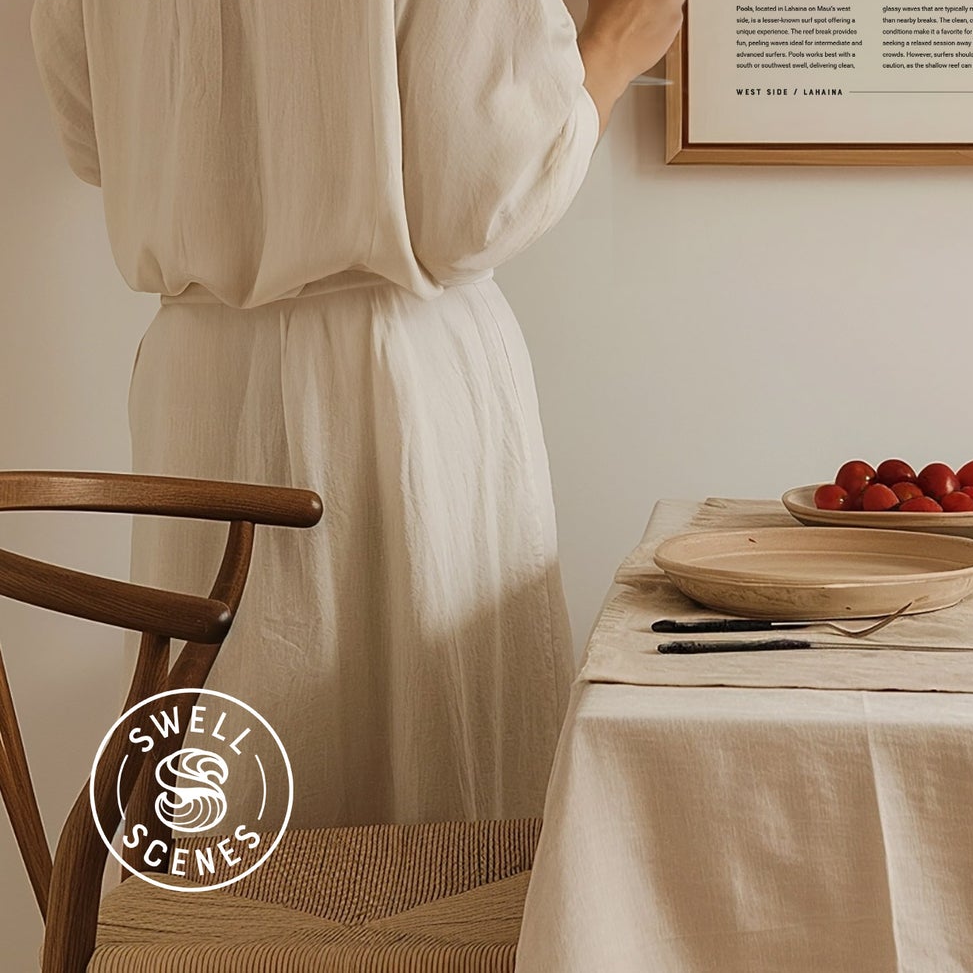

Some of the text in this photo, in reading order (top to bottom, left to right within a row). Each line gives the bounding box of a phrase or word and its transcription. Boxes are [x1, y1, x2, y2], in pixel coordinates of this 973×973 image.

[736, 5, 754, 13] Pools,
[882, 5, 901, 14] glassy
[945, 5, 968, 14] typically
[736, 17, 749, 25] side,
[814, 17, 827, 26] spot
[828, 17, 850, 26] offering
[897, 17, 916, 26] nearby
[952, 17, 968, 25] clean,
[736, 28, 755, 37] unique
[757, 28, 789, 37] experience.
[833, 28, 857, 37] provides
[736, 39, 747, 47] fun,
[748, 39, 769, 48] peeling
[883, 39, 905, 48] seeking
[792, 62, 808, 70] swell,
[809, 62, 837, 71] delivering
[838, 62, 855, 70] clean,
[882, 62, 905, 70] caution,
